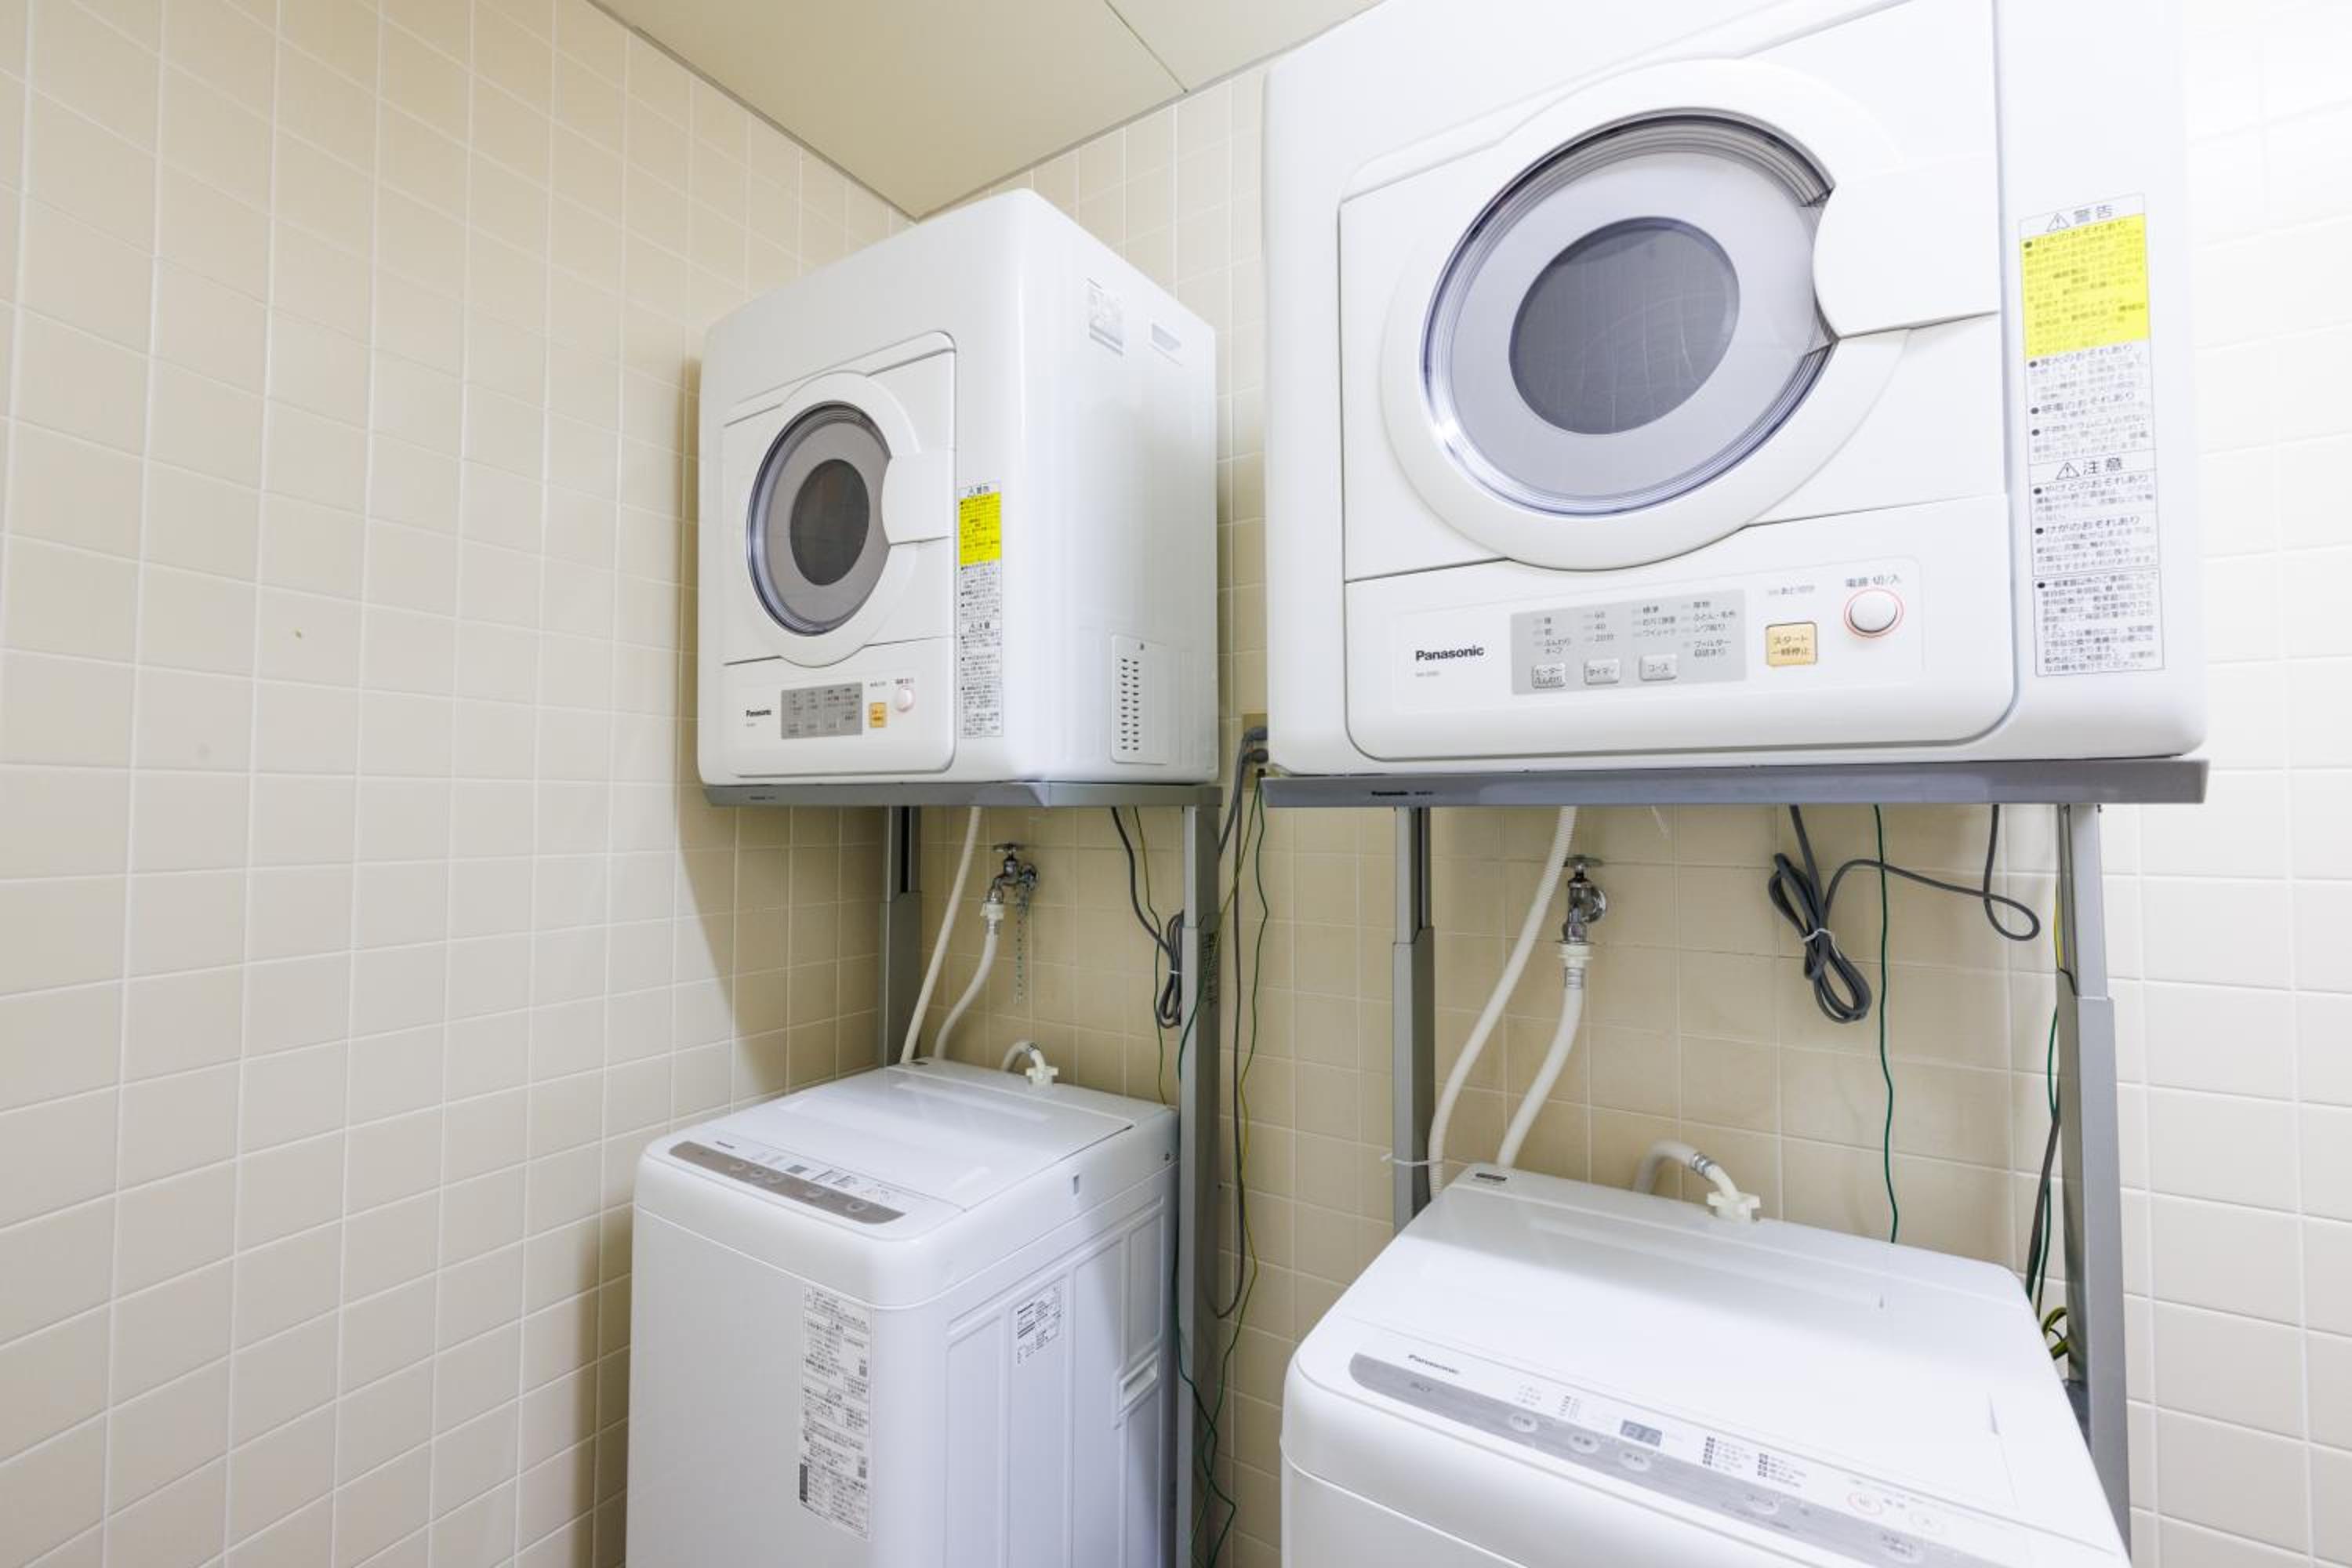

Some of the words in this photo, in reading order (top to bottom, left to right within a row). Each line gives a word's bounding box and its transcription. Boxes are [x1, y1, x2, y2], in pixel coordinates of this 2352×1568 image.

[2083, 457, 2122, 475] 注意
[1774, 633, 1809, 644] スタート
[1415, 644, 1484, 661] Panasonic
